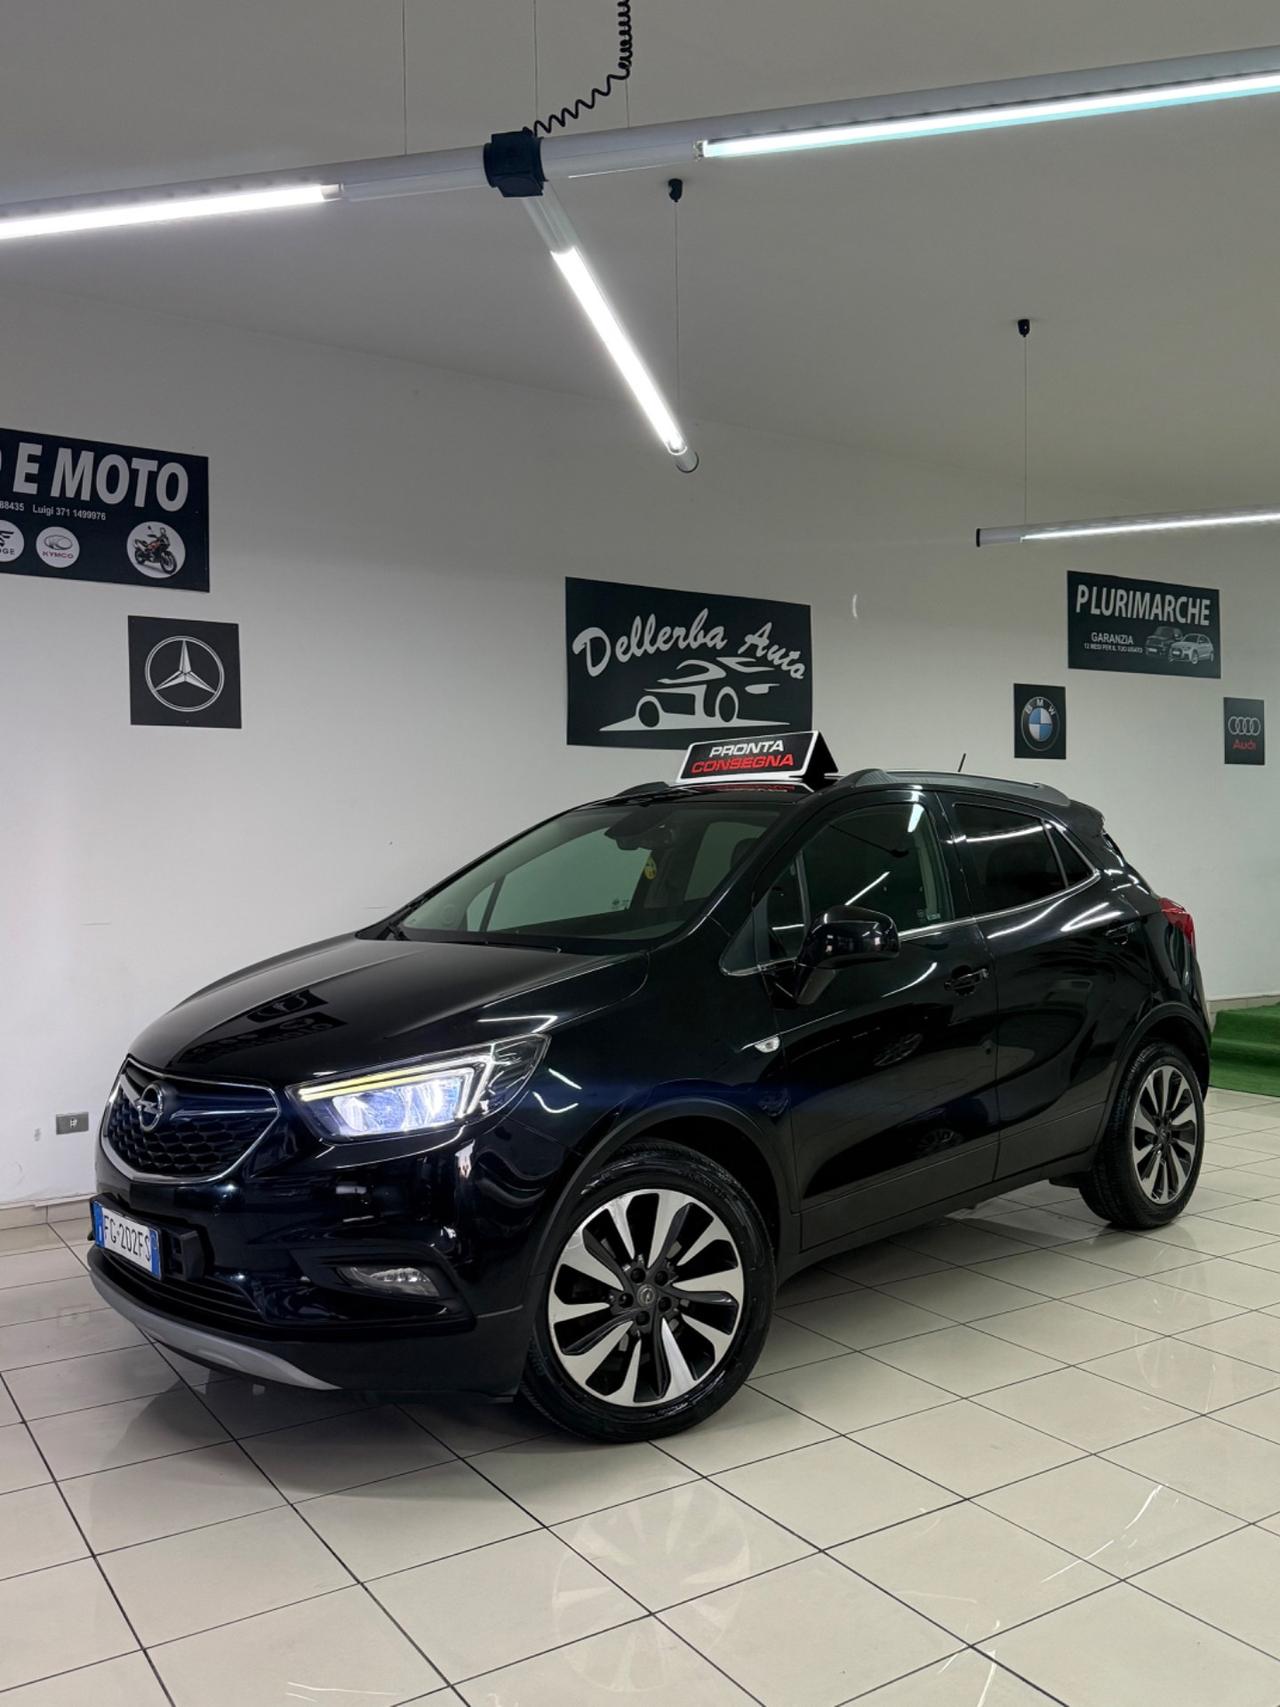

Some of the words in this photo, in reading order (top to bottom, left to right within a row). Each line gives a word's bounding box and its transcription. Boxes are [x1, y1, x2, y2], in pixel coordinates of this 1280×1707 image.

[13, 442, 43, 494] E
[50, 447, 189, 512] MOTO
[32, 504, 54, 516] Luigi
[56, 507, 70, 516] 371
[42, 551, 74, 559] KYMCO
[1076, 584, 1210, 626] PLURIMARCHE
[572, 608, 728, 677] Dellerba
[737, 622, 806, 680] Auto
[1091, 632, 1134, 645] GARANZIA
[1024, 698, 1056, 716] BMW
[709, 740, 785, 758] PRONTA
[1232, 739, 1257, 750] Audi
[691, 754, 795, 774] CONSEGNA
